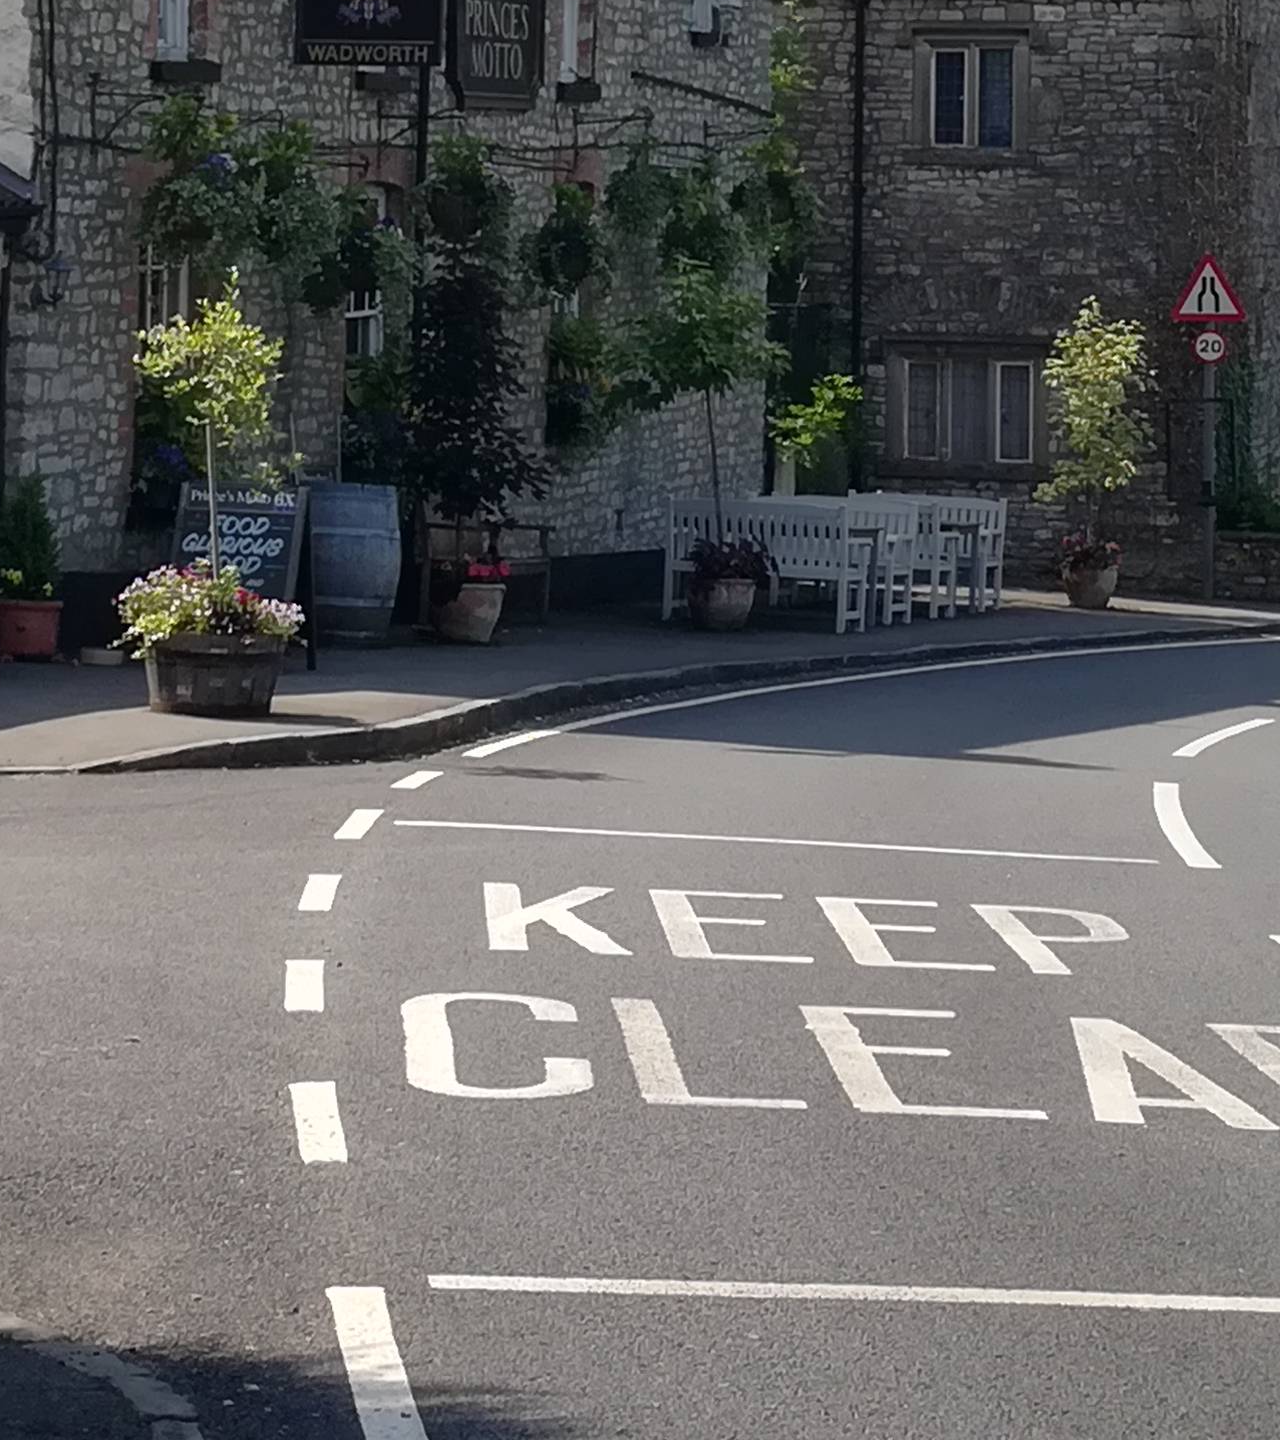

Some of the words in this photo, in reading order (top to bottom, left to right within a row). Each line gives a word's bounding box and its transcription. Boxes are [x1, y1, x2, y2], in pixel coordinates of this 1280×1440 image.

[307, 44, 428, 63] WADWORTH
[470, 41, 523, 79] MOTTO
[1199, 339, 1221, 353] 20
[191, 489, 234, 502] Price's
[208, 555, 261, 574] OOD
[483, 882, 1129, 975] KEEP
